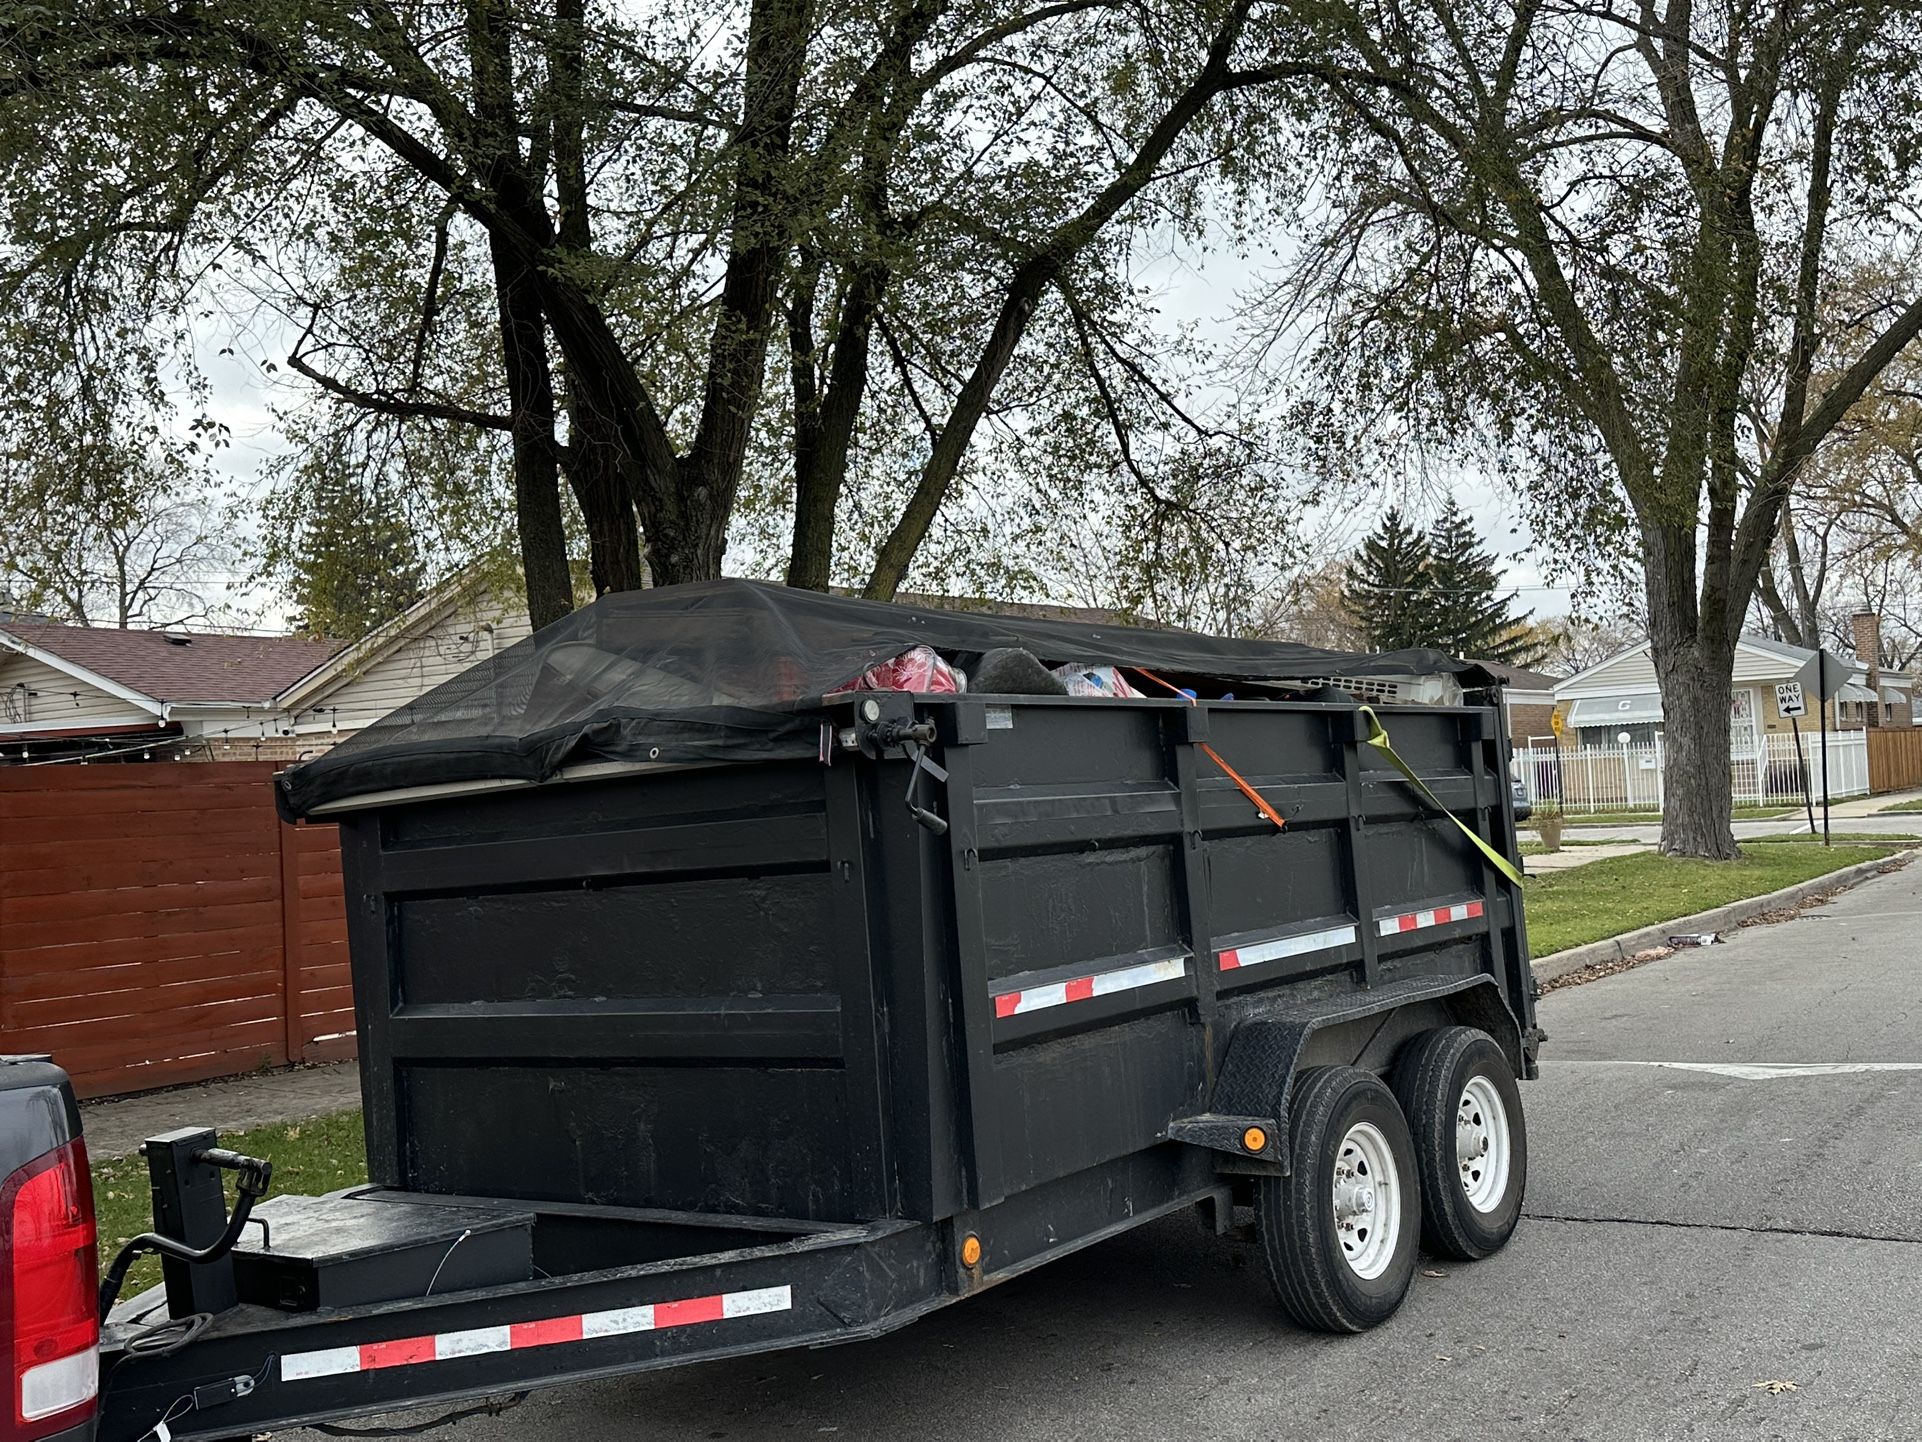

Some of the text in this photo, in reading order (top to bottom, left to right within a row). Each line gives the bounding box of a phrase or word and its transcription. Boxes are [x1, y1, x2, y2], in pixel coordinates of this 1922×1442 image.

[1778, 684, 1799, 695] ONE
[1779, 694, 1800, 704] WAY
[1618, 700, 1632, 710] G
